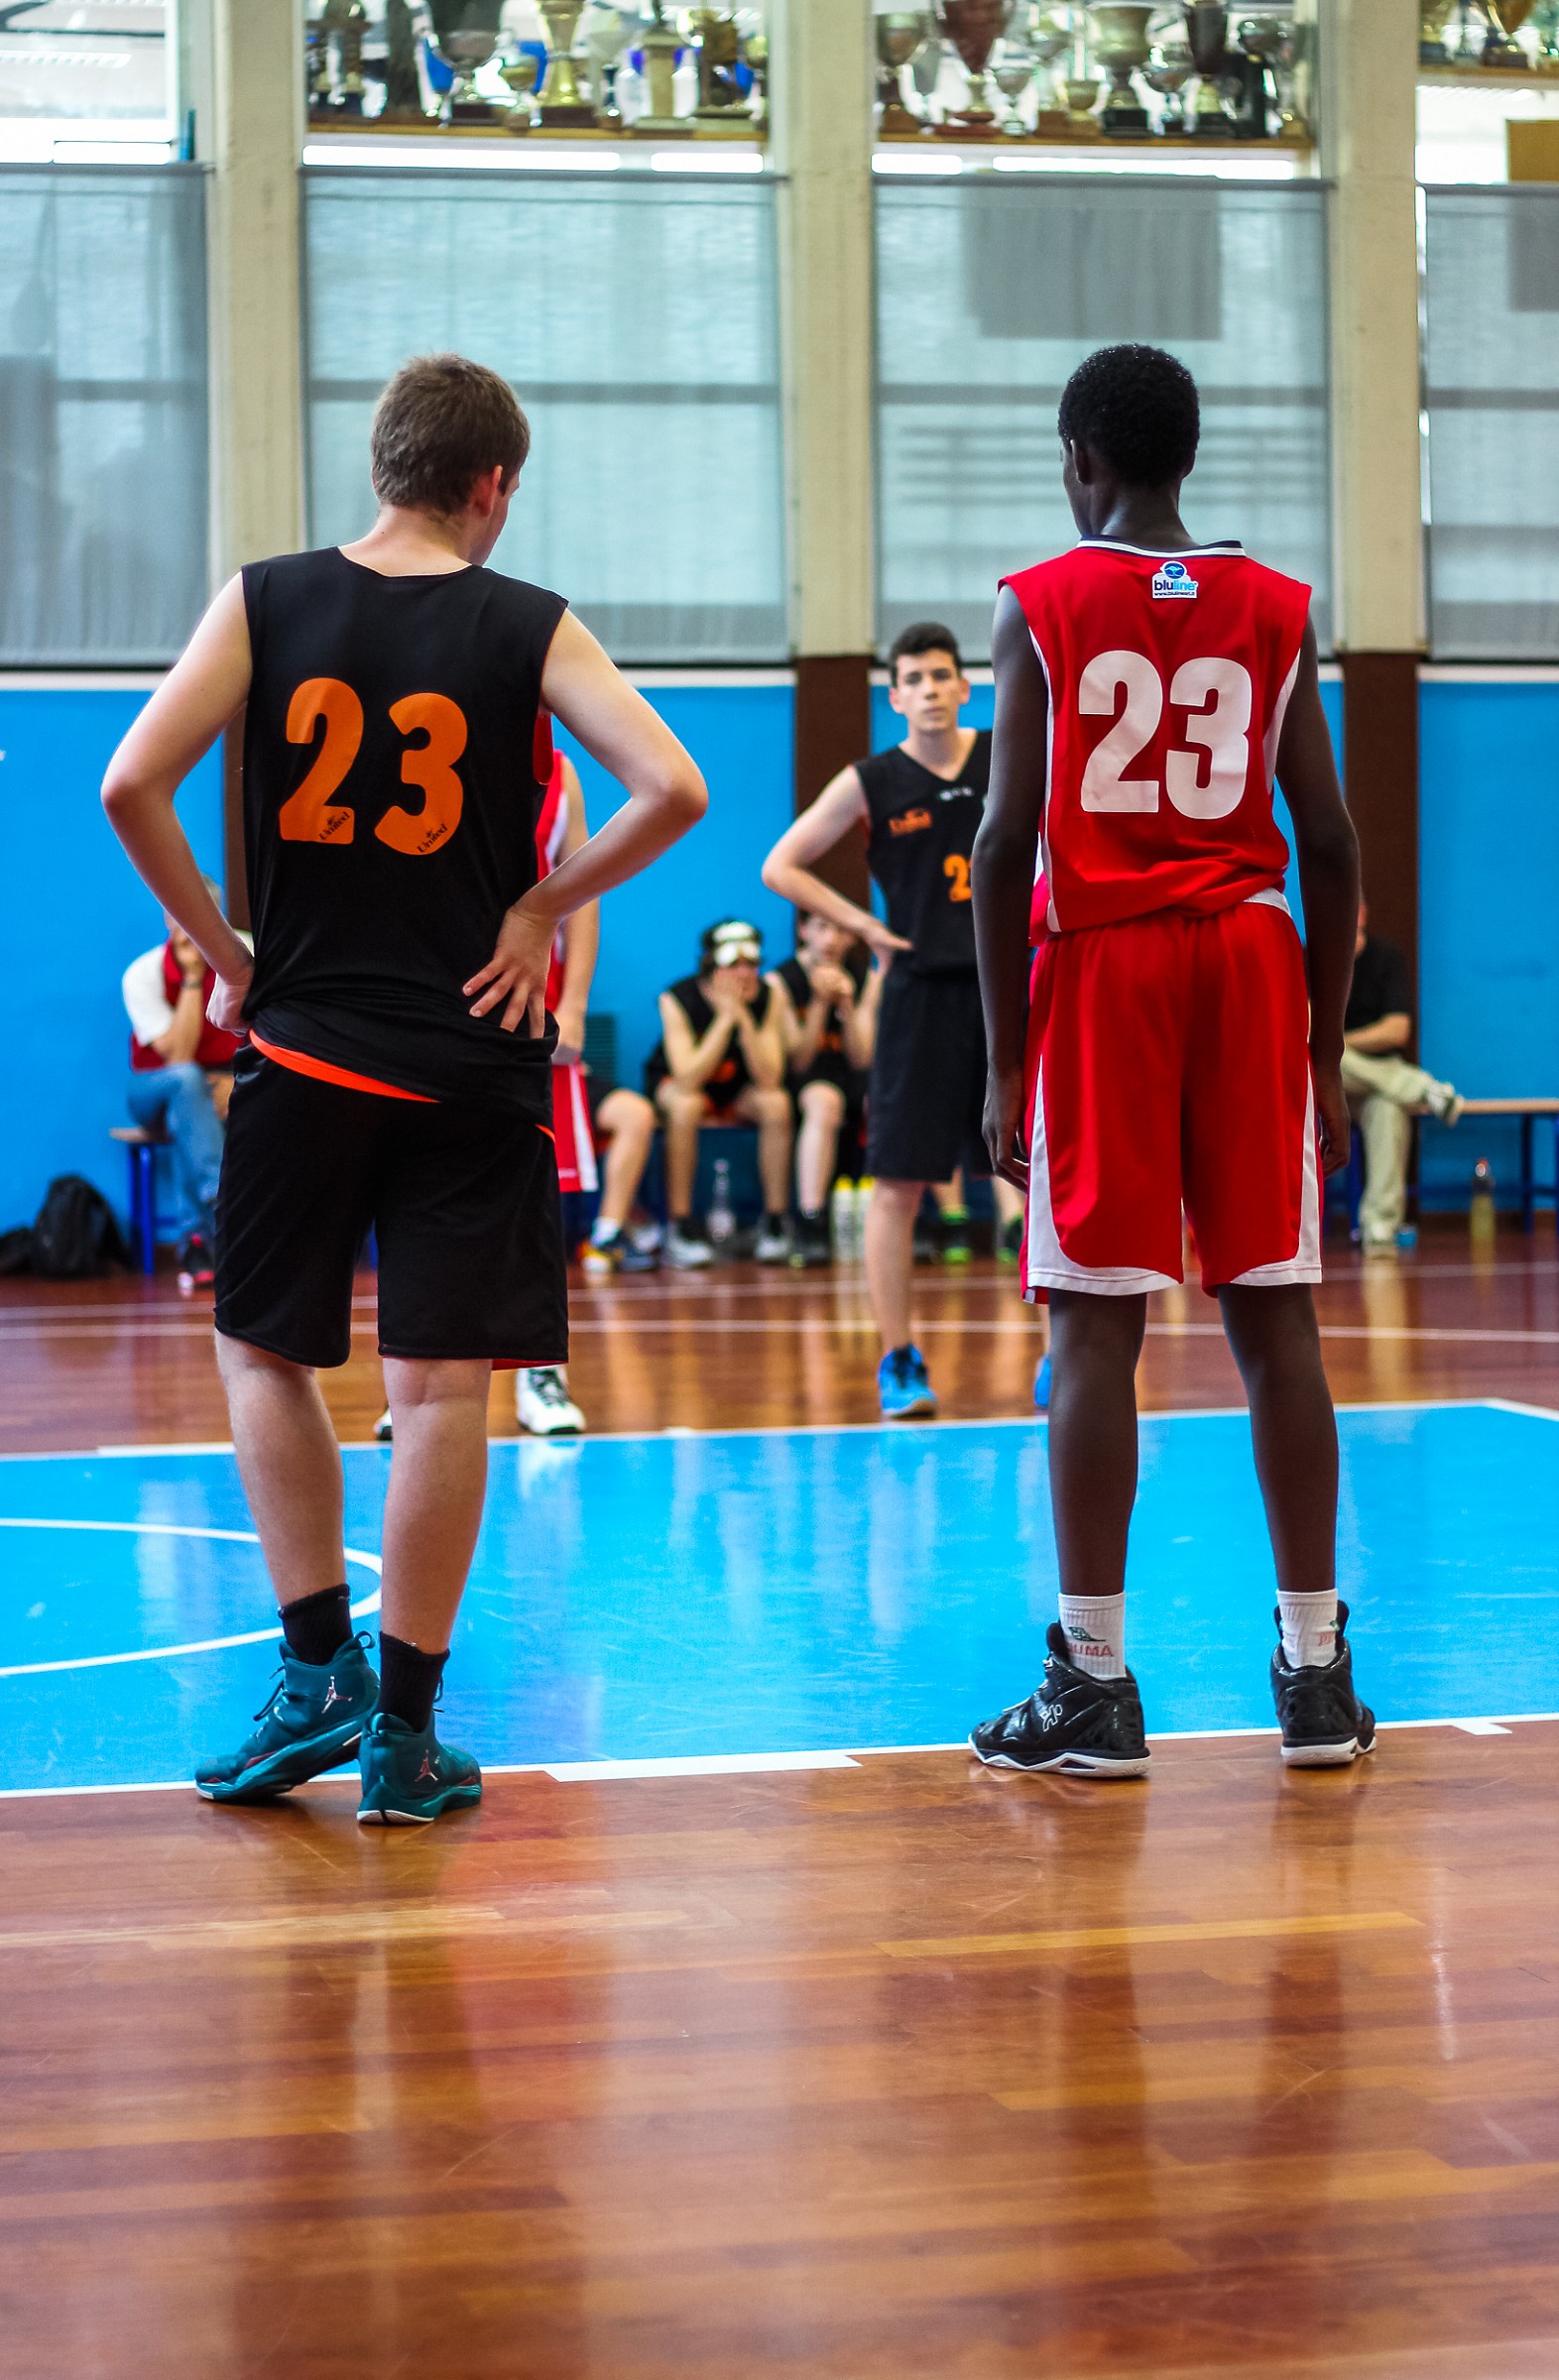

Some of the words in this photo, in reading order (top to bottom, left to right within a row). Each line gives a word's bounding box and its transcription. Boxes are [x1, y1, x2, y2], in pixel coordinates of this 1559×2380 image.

[1154, 579, 1195, 591] bluline
[1078, 650, 1253, 820] 23
[279, 676, 468, 856] 23
[318, 810, 351, 841] United
[417, 823, 449, 854] United
